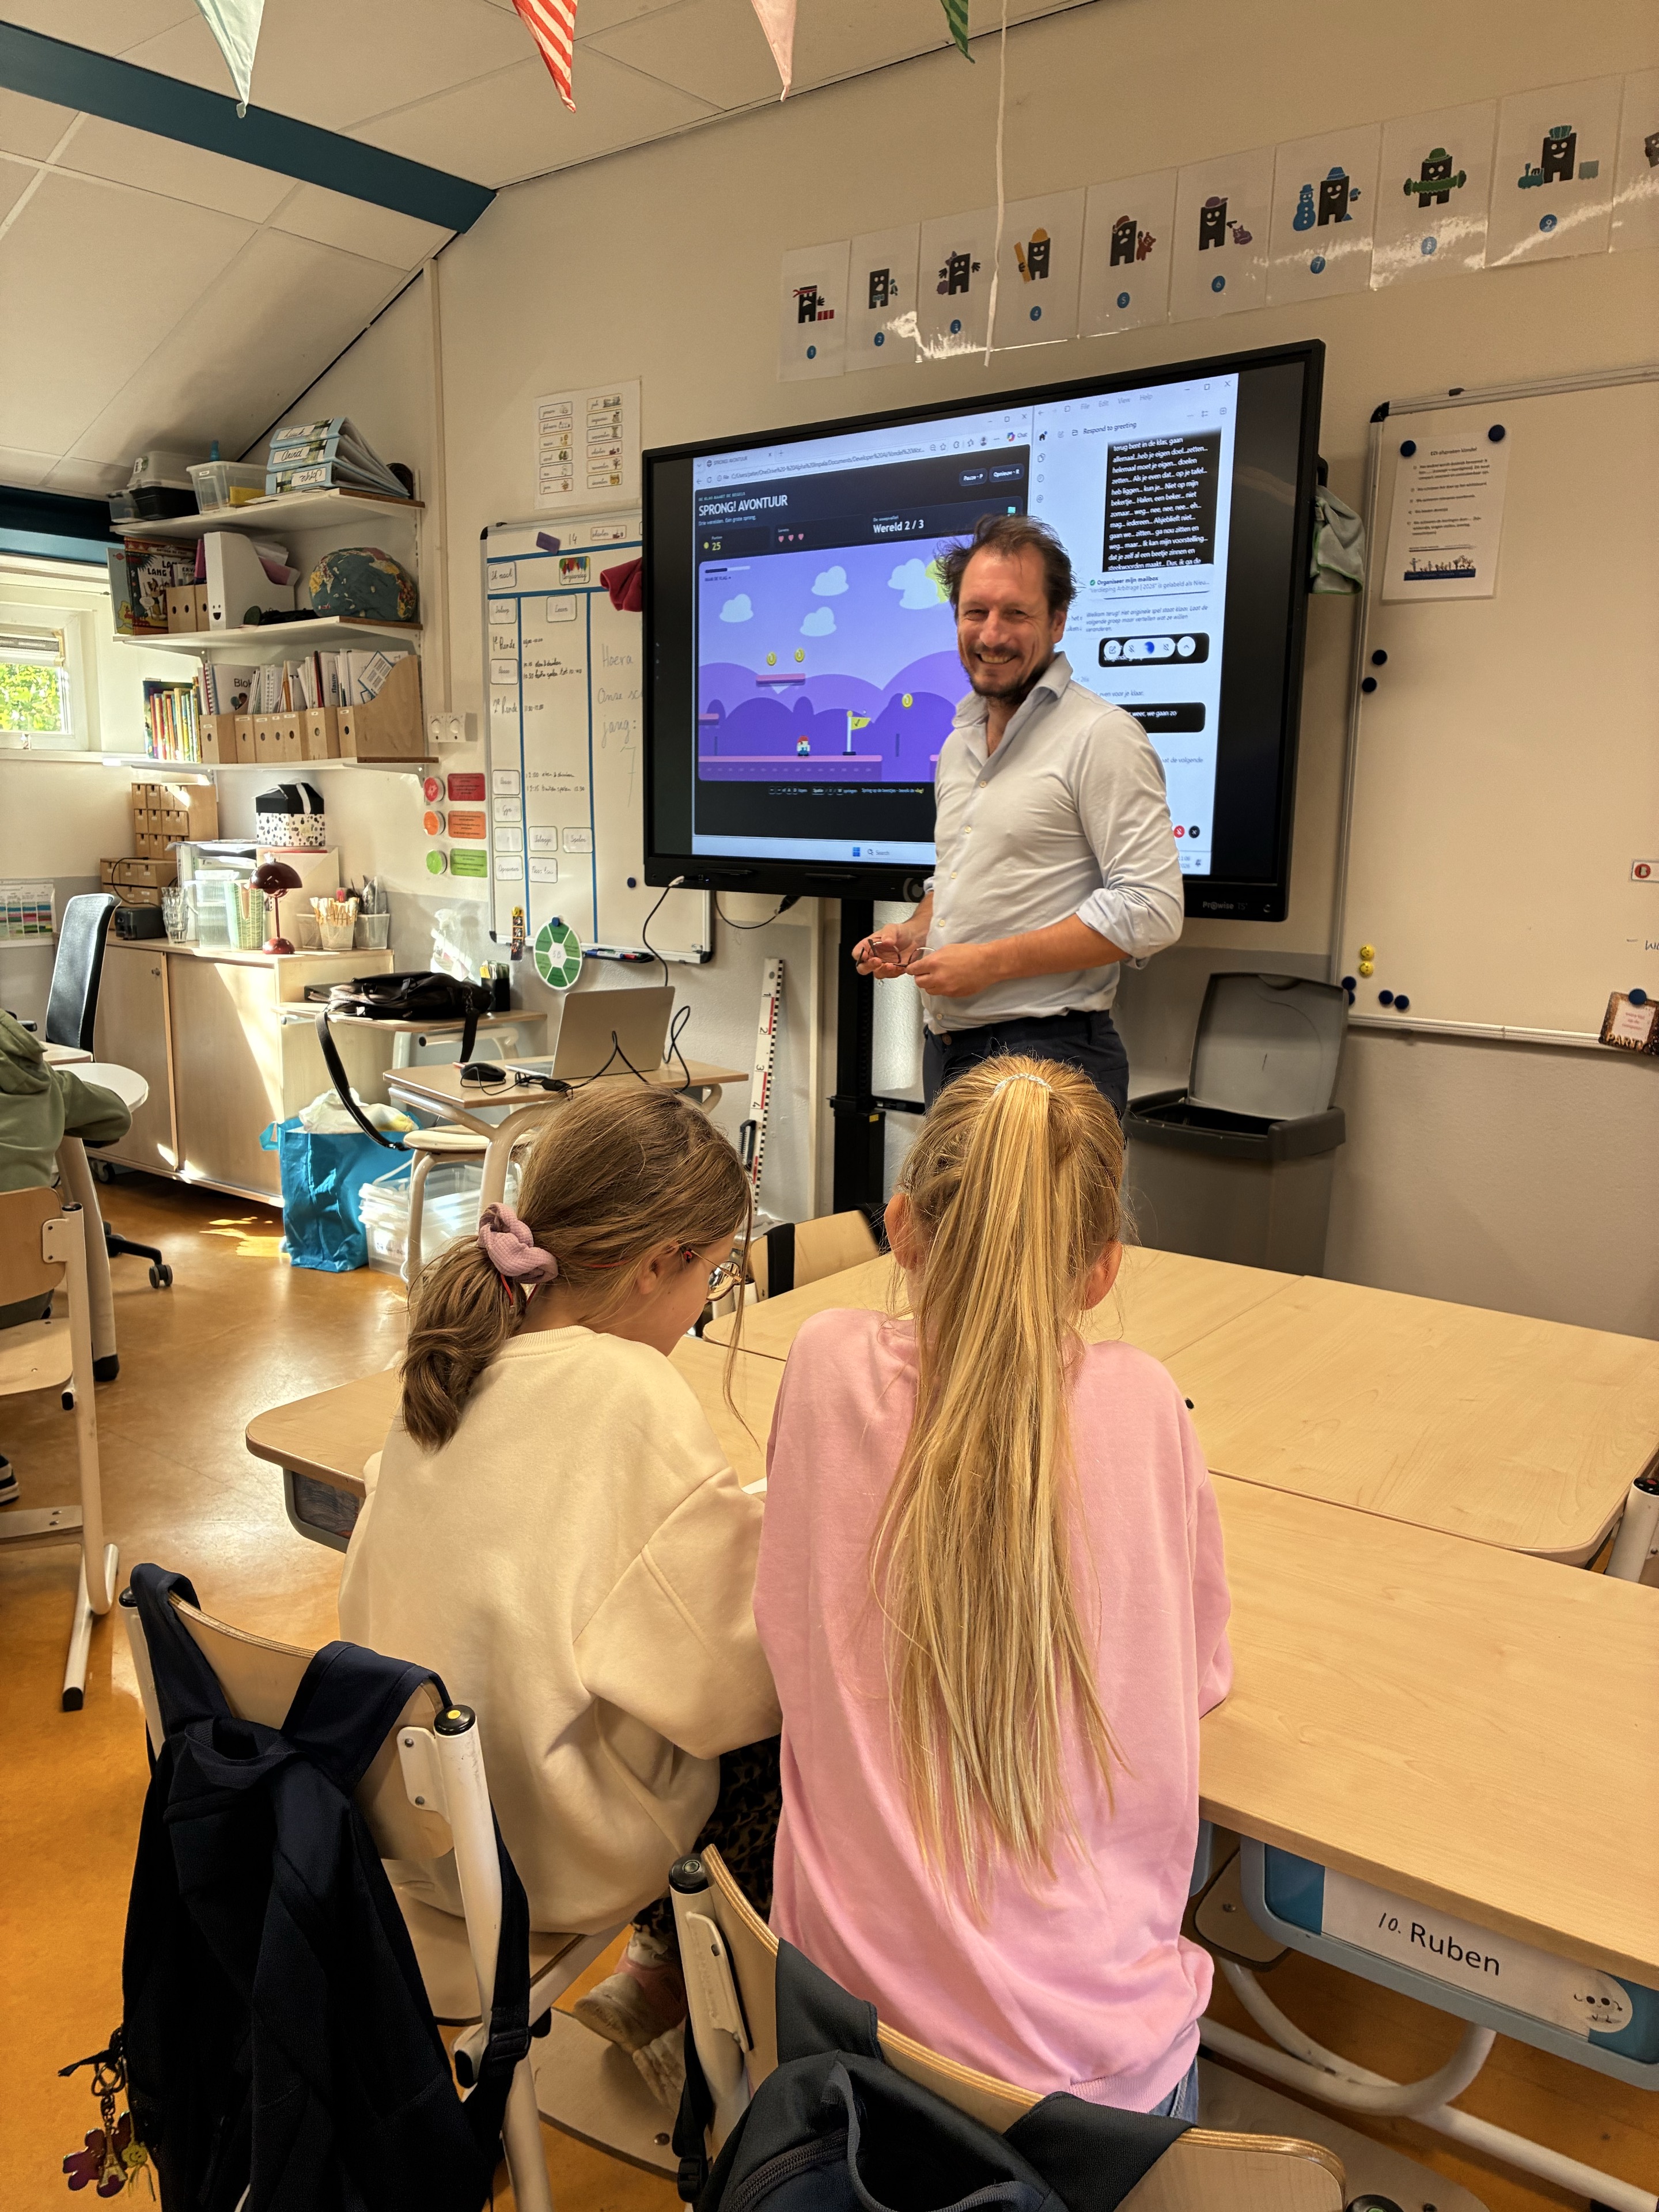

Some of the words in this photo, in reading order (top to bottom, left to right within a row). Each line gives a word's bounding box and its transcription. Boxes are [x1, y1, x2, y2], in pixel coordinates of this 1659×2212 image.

[1083, 425, 1105, 434] Respond
[1114, 422, 1137, 431] greeting
[1137, 463, 1150, 471] moet
[1186, 480, 1199, 488] mijn
[699, 501, 736, 516] SPRONG!
[738, 495, 788, 512] AVONTUUR
[873, 521, 902, 533] Wereld
[904, 521, 910, 530] 2
[912, 520, 916, 529] /
[918, 520, 924, 529] 3
[712, 542, 721, 551] 25
[1160, 538, 1172, 546] mijn
[601, 643, 632, 667] Hoera
[1410, 1922, 1501, 1976] Ruben
